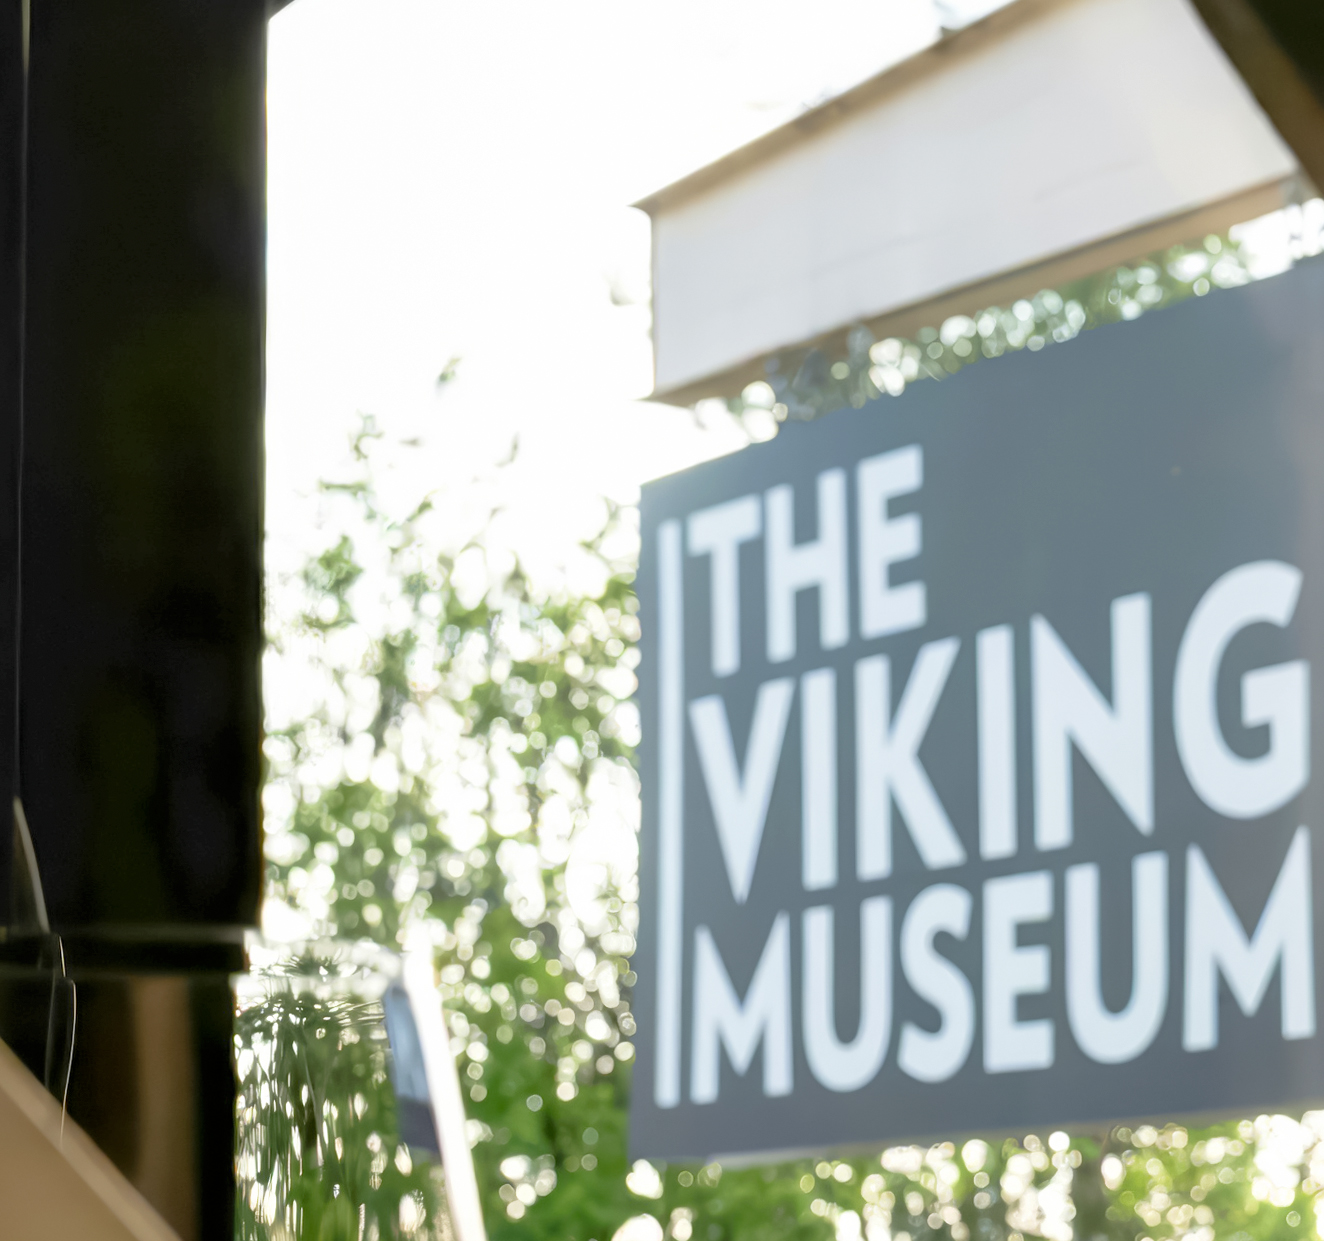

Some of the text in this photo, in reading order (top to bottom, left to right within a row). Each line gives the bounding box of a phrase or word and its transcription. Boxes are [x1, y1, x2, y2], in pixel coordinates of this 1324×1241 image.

[685, 444, 927, 678] THE
[687, 559, 1312, 905] VIKING
[689, 825, 1317, 1105] MUSEUM
